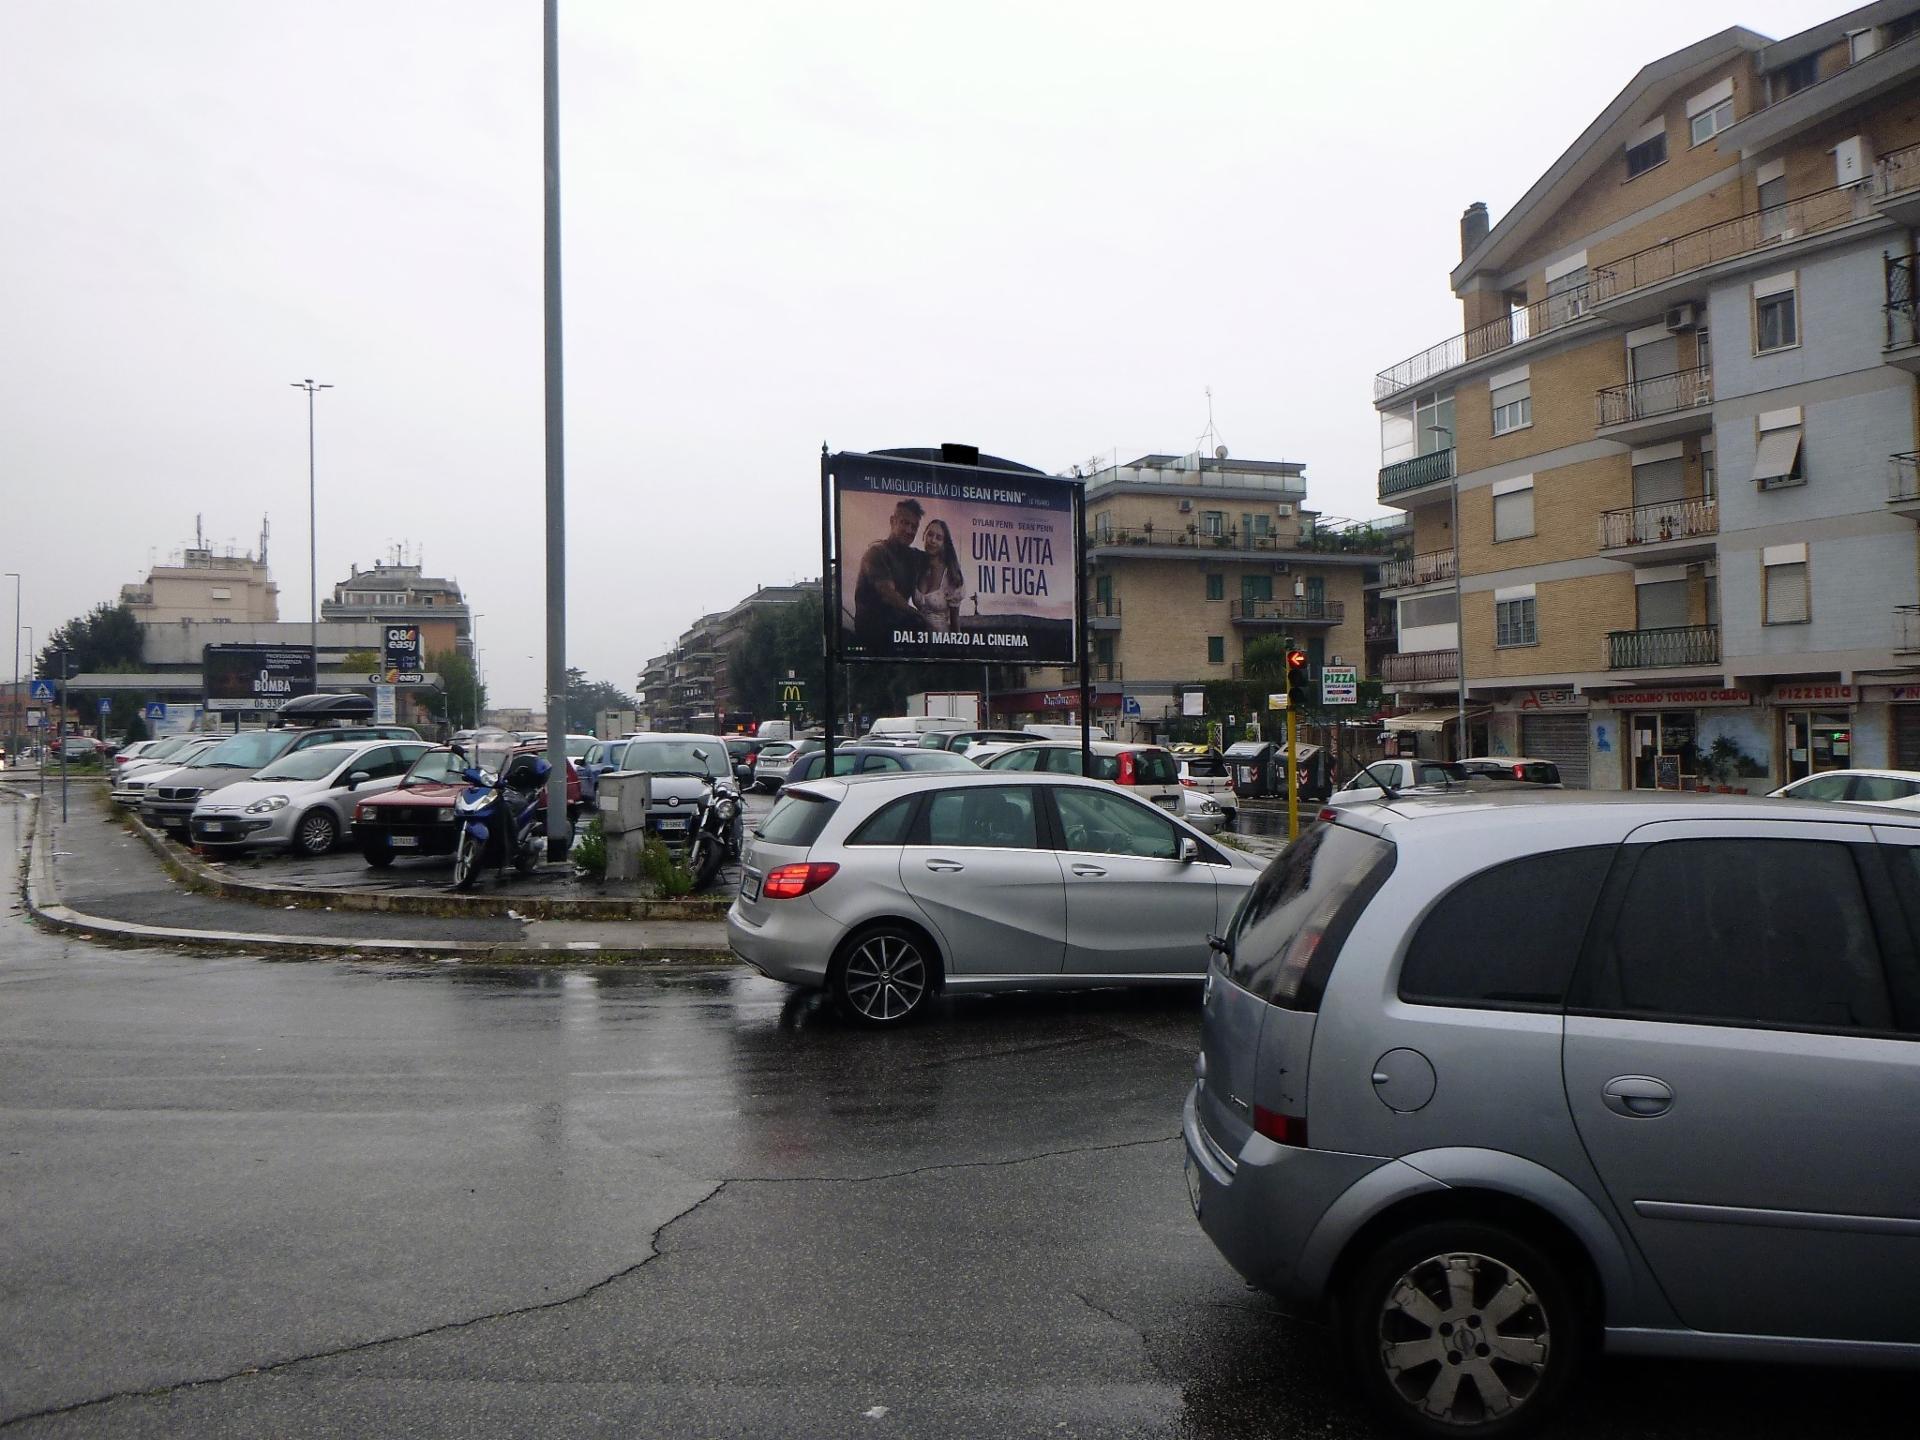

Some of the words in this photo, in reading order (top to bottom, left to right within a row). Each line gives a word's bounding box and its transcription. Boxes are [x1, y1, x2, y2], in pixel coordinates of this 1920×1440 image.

[882, 477, 924, 493] MIGLIOR
[926, 481, 949, 496] FILM
[951, 485, 961, 498] DI
[963, 486, 991, 501] SEAN
[972, 518, 995, 528] DYLAN
[995, 520, 1014, 529] PENN
[1018, 522, 1035, 531] SEAN
[1036, 523, 1054, 533] PENN
[972, 532, 1010, 563] UNA
[1015, 534, 1054, 566] VITA
[978, 565, 996, 593] IN
[1002, 569, 1049, 597] FUGA
[388, 640, 417, 651] easy
[893, 630, 916, 644] DAL
[917, 631, 929, 644] 31
[932, 631, 970, 645] MARZO
[972, 632, 986, 646] AL
[987, 633, 1029, 647] CINEMA
[254, 680, 291, 692] BOMBA
[399, 674, 421, 684] easy
[1324, 673, 1355, 684] PIZZA
